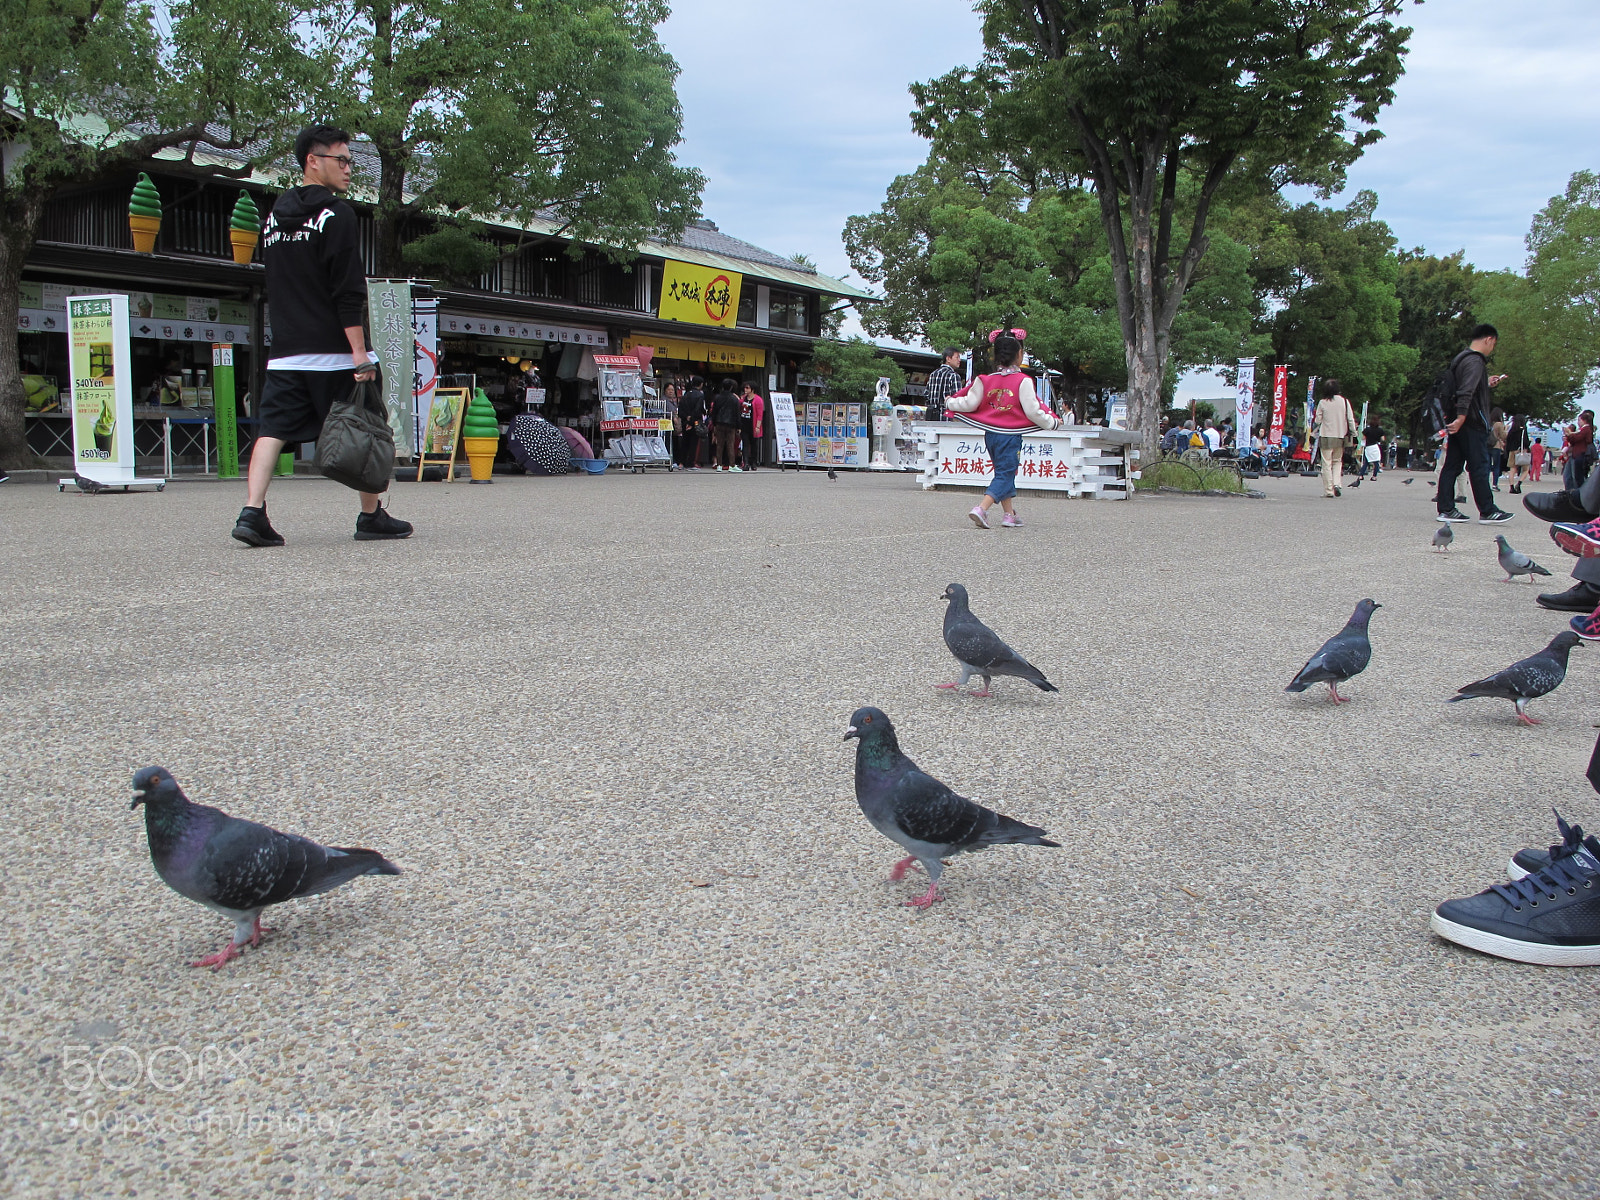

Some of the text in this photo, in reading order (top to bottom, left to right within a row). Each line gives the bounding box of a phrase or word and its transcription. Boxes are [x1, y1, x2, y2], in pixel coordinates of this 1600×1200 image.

[75, 378, 104, 388] 540Yen
[632, 420, 645, 428] SALE
[645, 420, 659, 428] SALE
[80, 448, 110, 459] 450Yen
